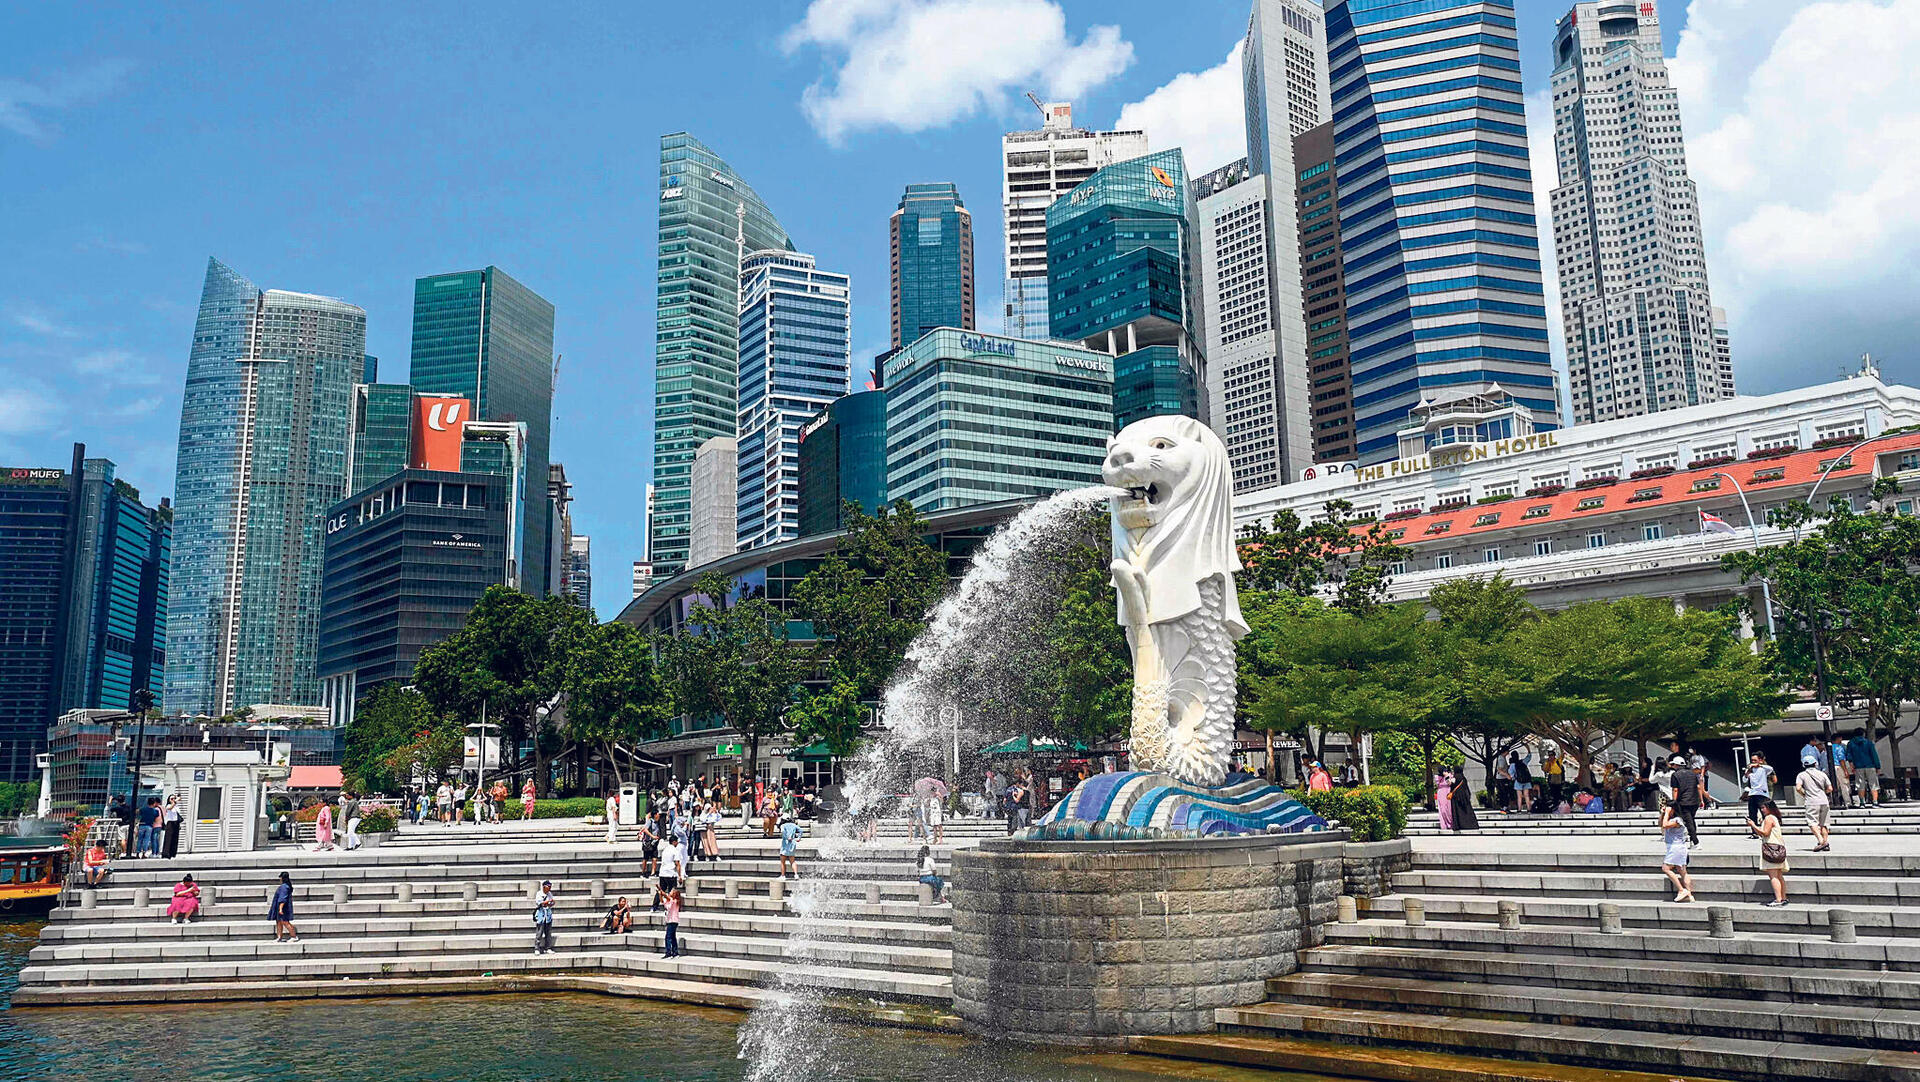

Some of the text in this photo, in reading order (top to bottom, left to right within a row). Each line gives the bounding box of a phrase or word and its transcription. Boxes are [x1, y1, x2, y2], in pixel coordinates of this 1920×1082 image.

[1071, 185, 1094, 205] MYP
[1149, 187, 1176, 200] MYP
[1055, 353, 1107, 371] wework
[1354, 432, 1558, 482] THE FULLERTON HOTEL
[29, 470, 60, 478] MUFG
